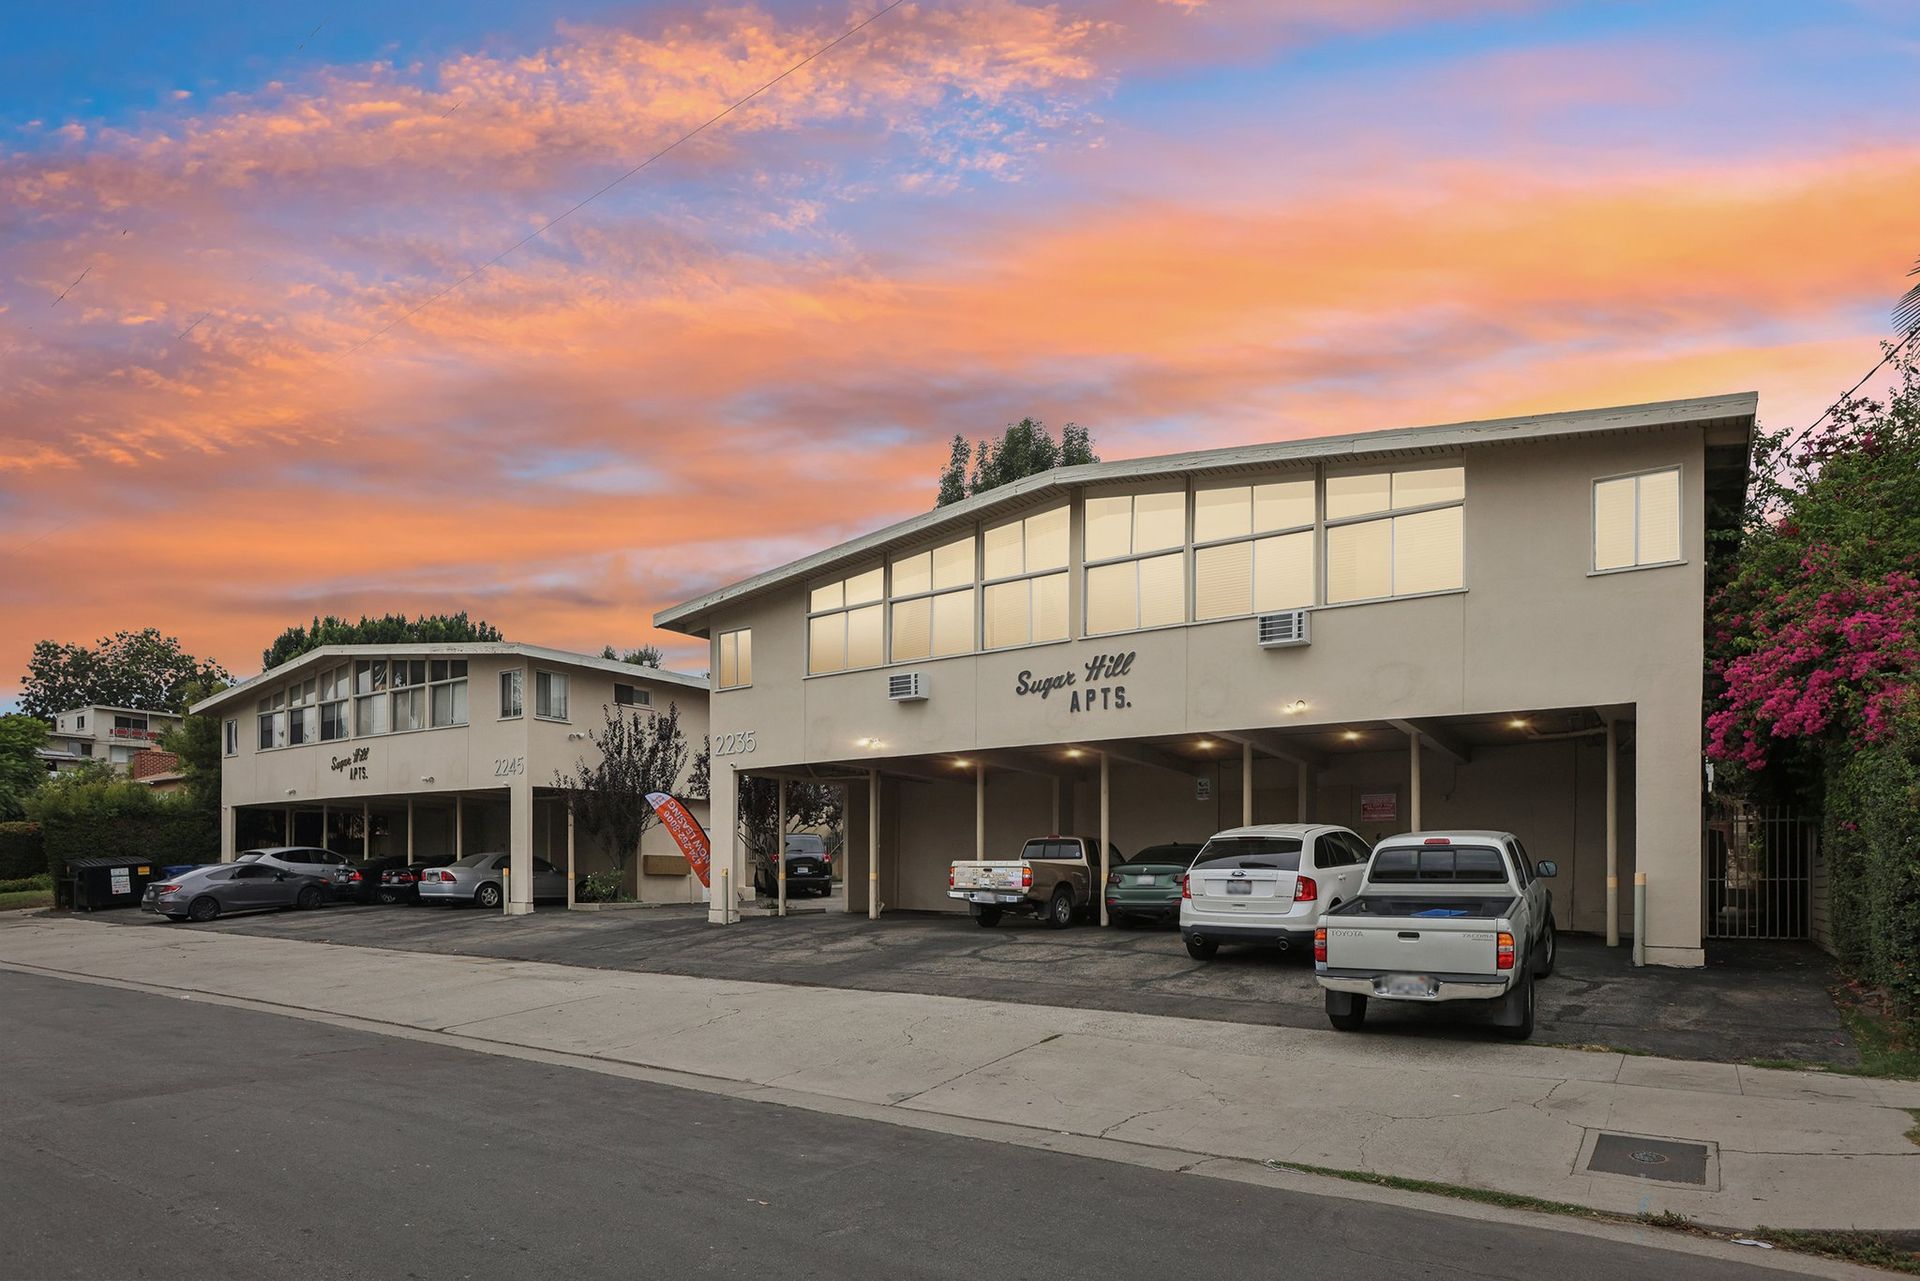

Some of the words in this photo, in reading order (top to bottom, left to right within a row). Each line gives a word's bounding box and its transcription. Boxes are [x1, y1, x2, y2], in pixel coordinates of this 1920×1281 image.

[1016, 670, 1076, 699] Sugar
[1085, 651, 1136, 682] Hill
[1070, 686, 1132, 712] APTS.
[715, 730, 756, 756] 2235
[331, 756, 352, 772] Sugar
[353, 747, 369, 763] Hill
[494, 757, 525, 776] 2245
[349, 767, 368, 780] APTS.
[667, 800, 697, 840] LEASING
[693, 840, 710, 864] NOW
